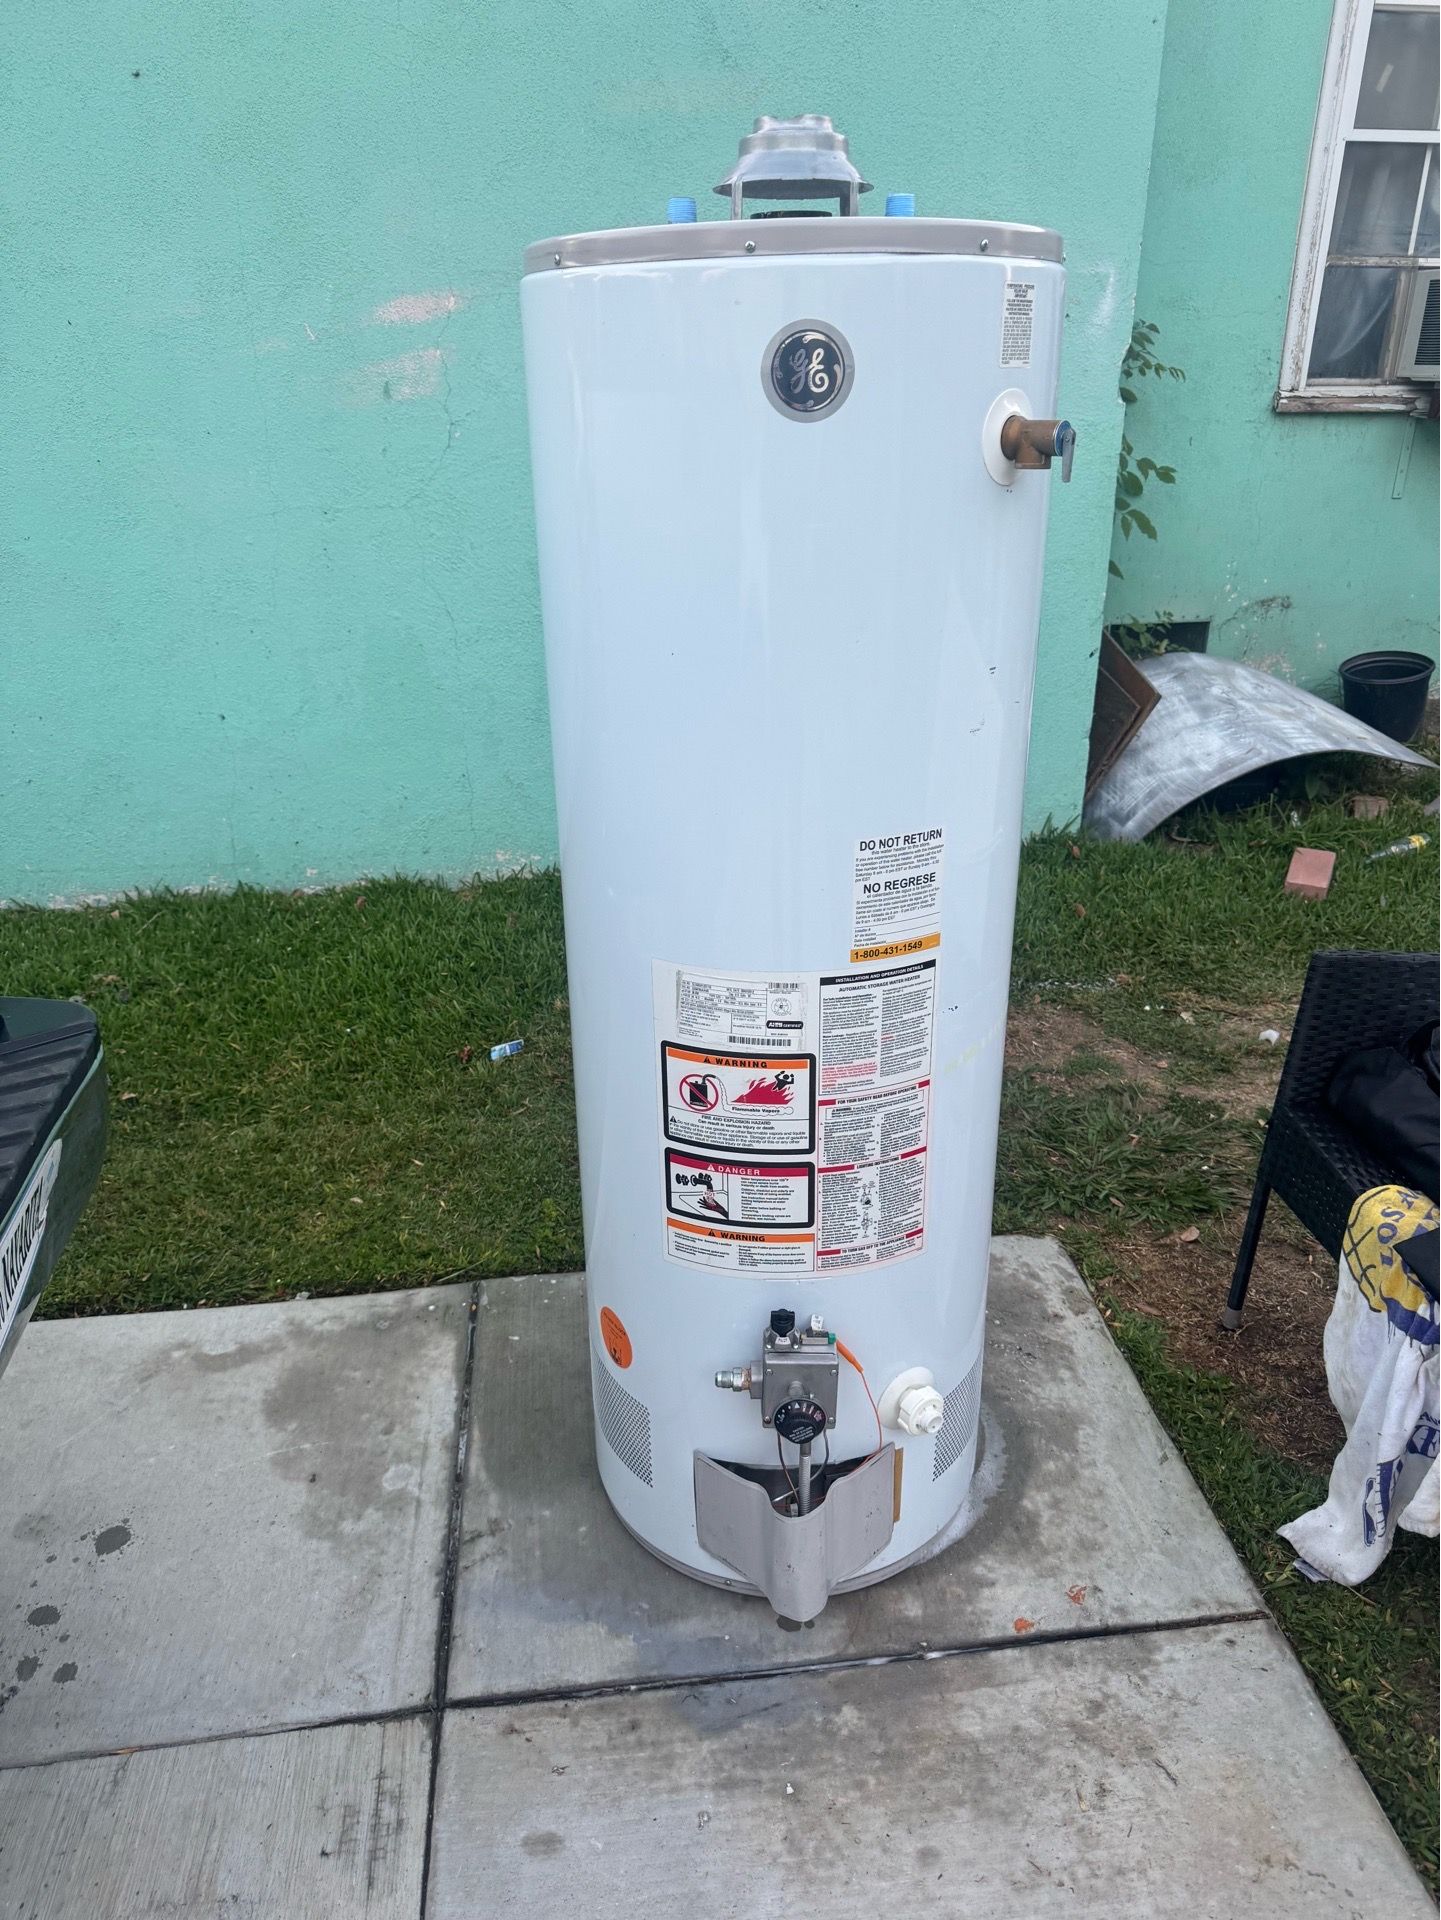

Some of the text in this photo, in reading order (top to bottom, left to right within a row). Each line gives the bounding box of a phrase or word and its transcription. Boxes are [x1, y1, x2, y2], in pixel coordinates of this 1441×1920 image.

[860, 828, 942, 851] DO NOT RETURN
[864, 872, 936, 894] NO REGRESE
[854, 941, 922, 960] 1-800-431-1549
[836, 975, 869, 983] INSTALLATION
[881, 968, 906, 977] OPERATION
[716, 1059, 767, 1068] WARNING
[898, 1086, 916, 1094] OPERATING
[719, 1166, 760, 1175] DANGER
[721, 1232, 765, 1242] WARNING
[887, 1237, 904, 1245] APPLIANCE
[1377, 1206, 1406, 1268] LOS
